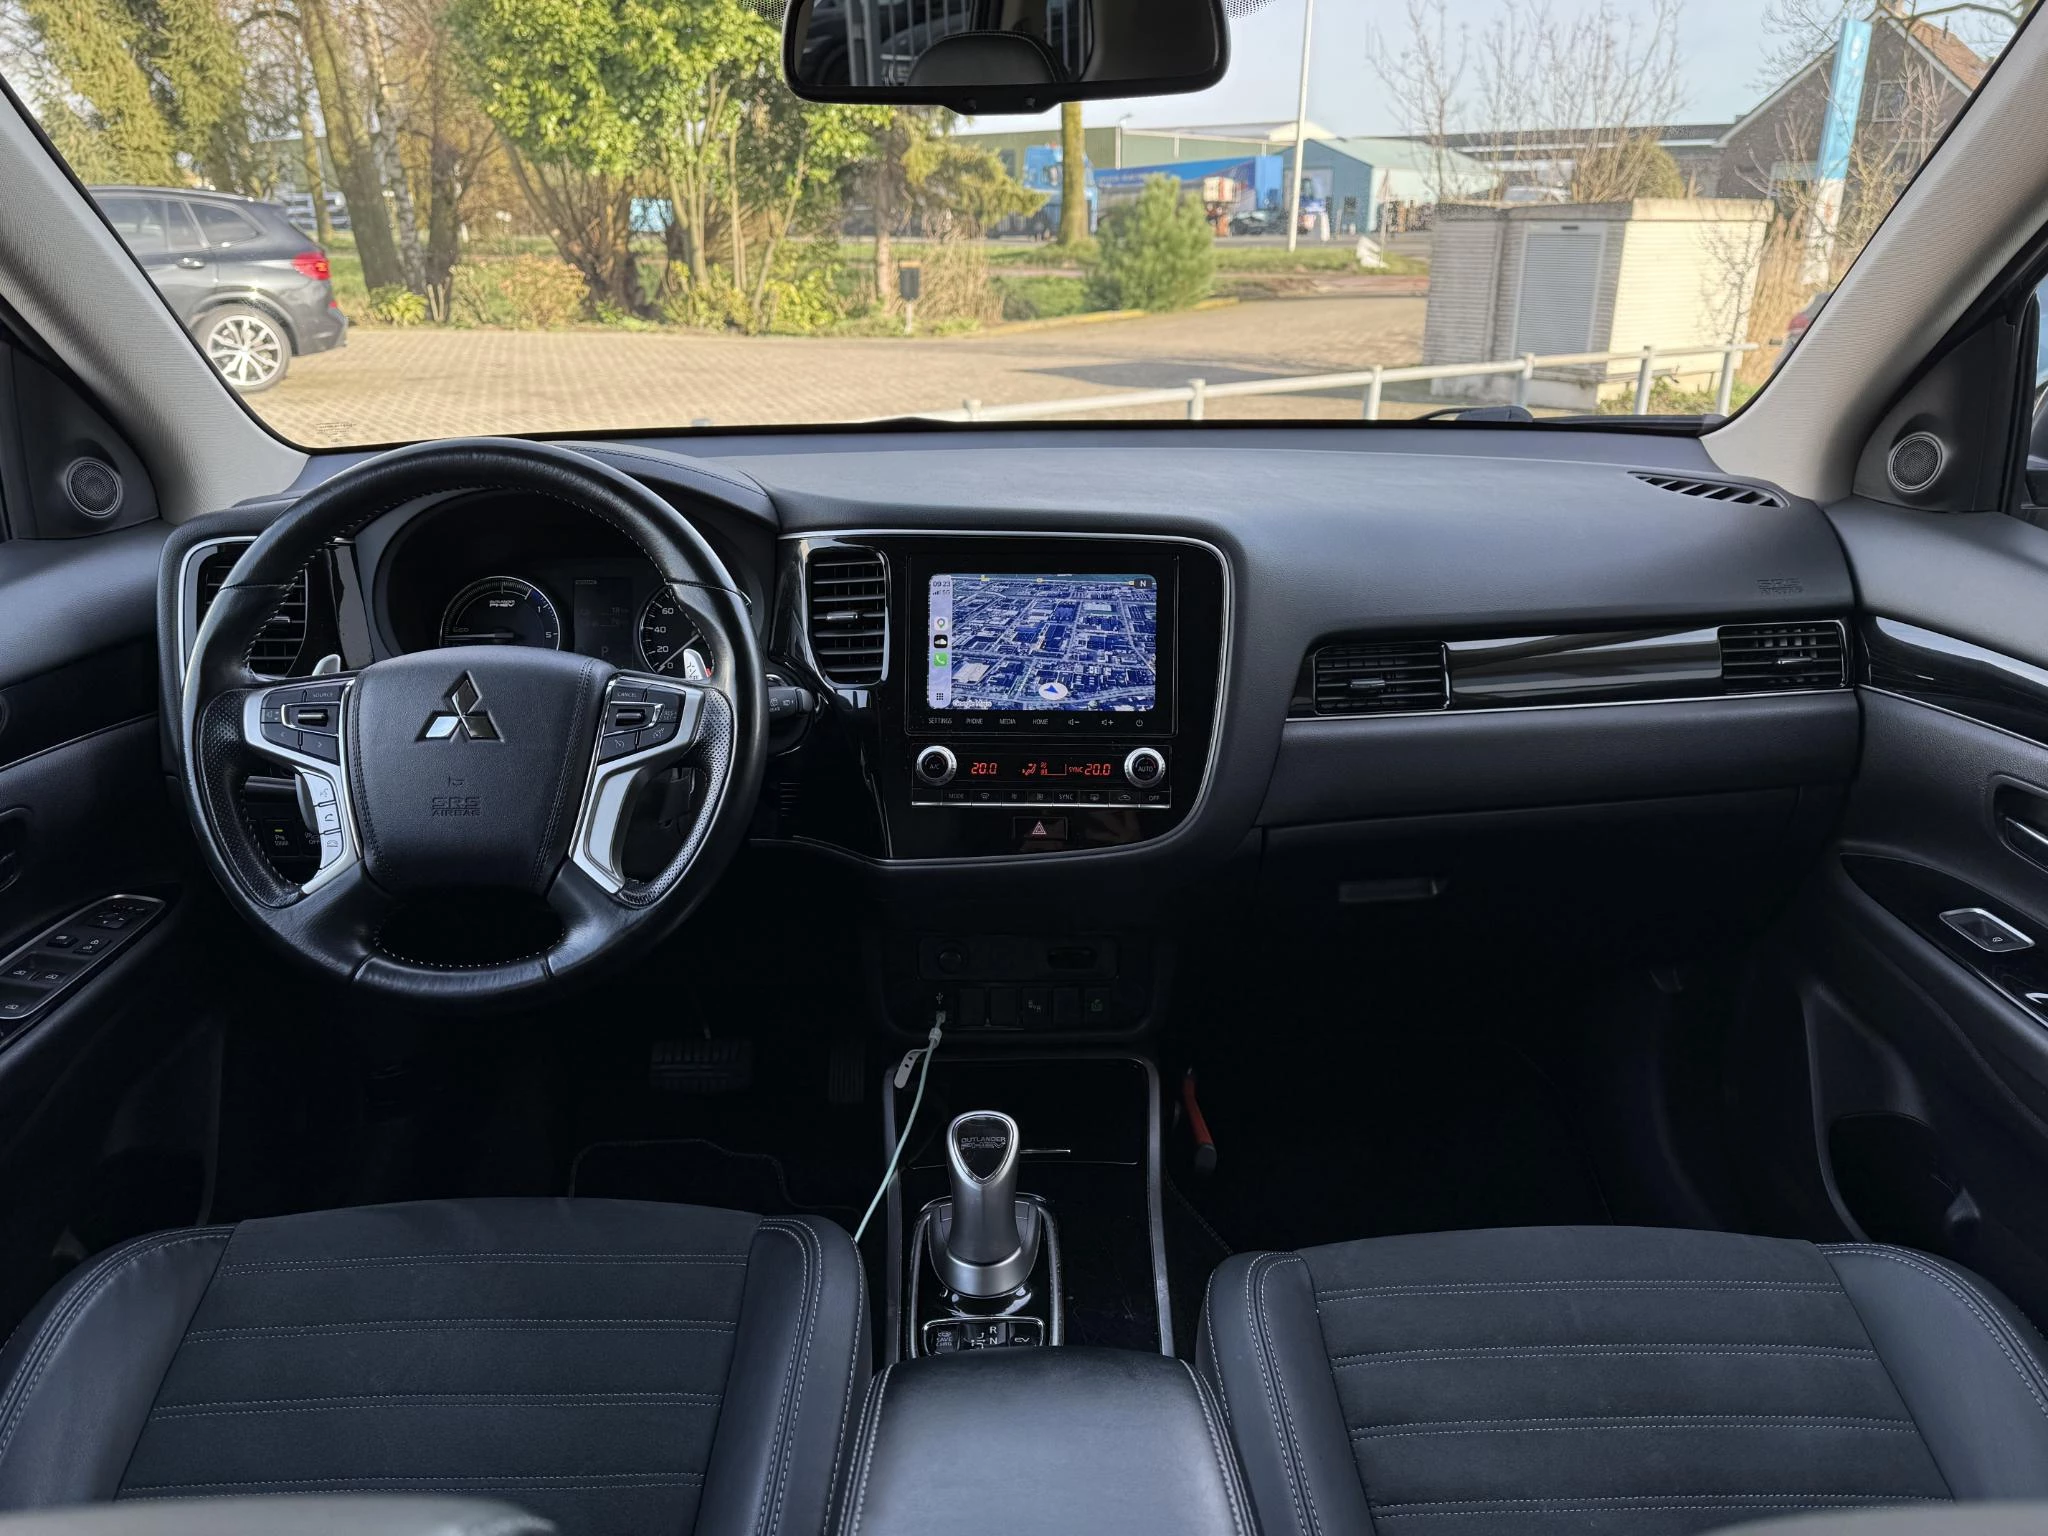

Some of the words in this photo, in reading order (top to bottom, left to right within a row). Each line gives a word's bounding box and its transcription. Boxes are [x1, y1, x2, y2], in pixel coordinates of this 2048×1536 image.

[1140, 579, 1147, 588] N
[661, 607, 675, 616] 60
[653, 626, 667, 634] 40
[656, 644, 670, 653] 20
[928, 717, 953, 725] SETTINGS
[965, 717, 983, 725] PHONE
[999, 717, 1016, 725] MEDIA
[1032, 717, 1049, 726] HOME
[971, 762, 997, 775] 20.0
[1069, 765, 1084, 774] SYNC
[1084, 763, 1111, 776] 20.0
[1137, 765, 1154, 773] AUTO
[1058, 793, 1074, 801] SYNC
[961, 1136, 1006, 1144] OUTLANDER
[989, 1325, 997, 1334] R
[989, 1336, 998, 1345] N
